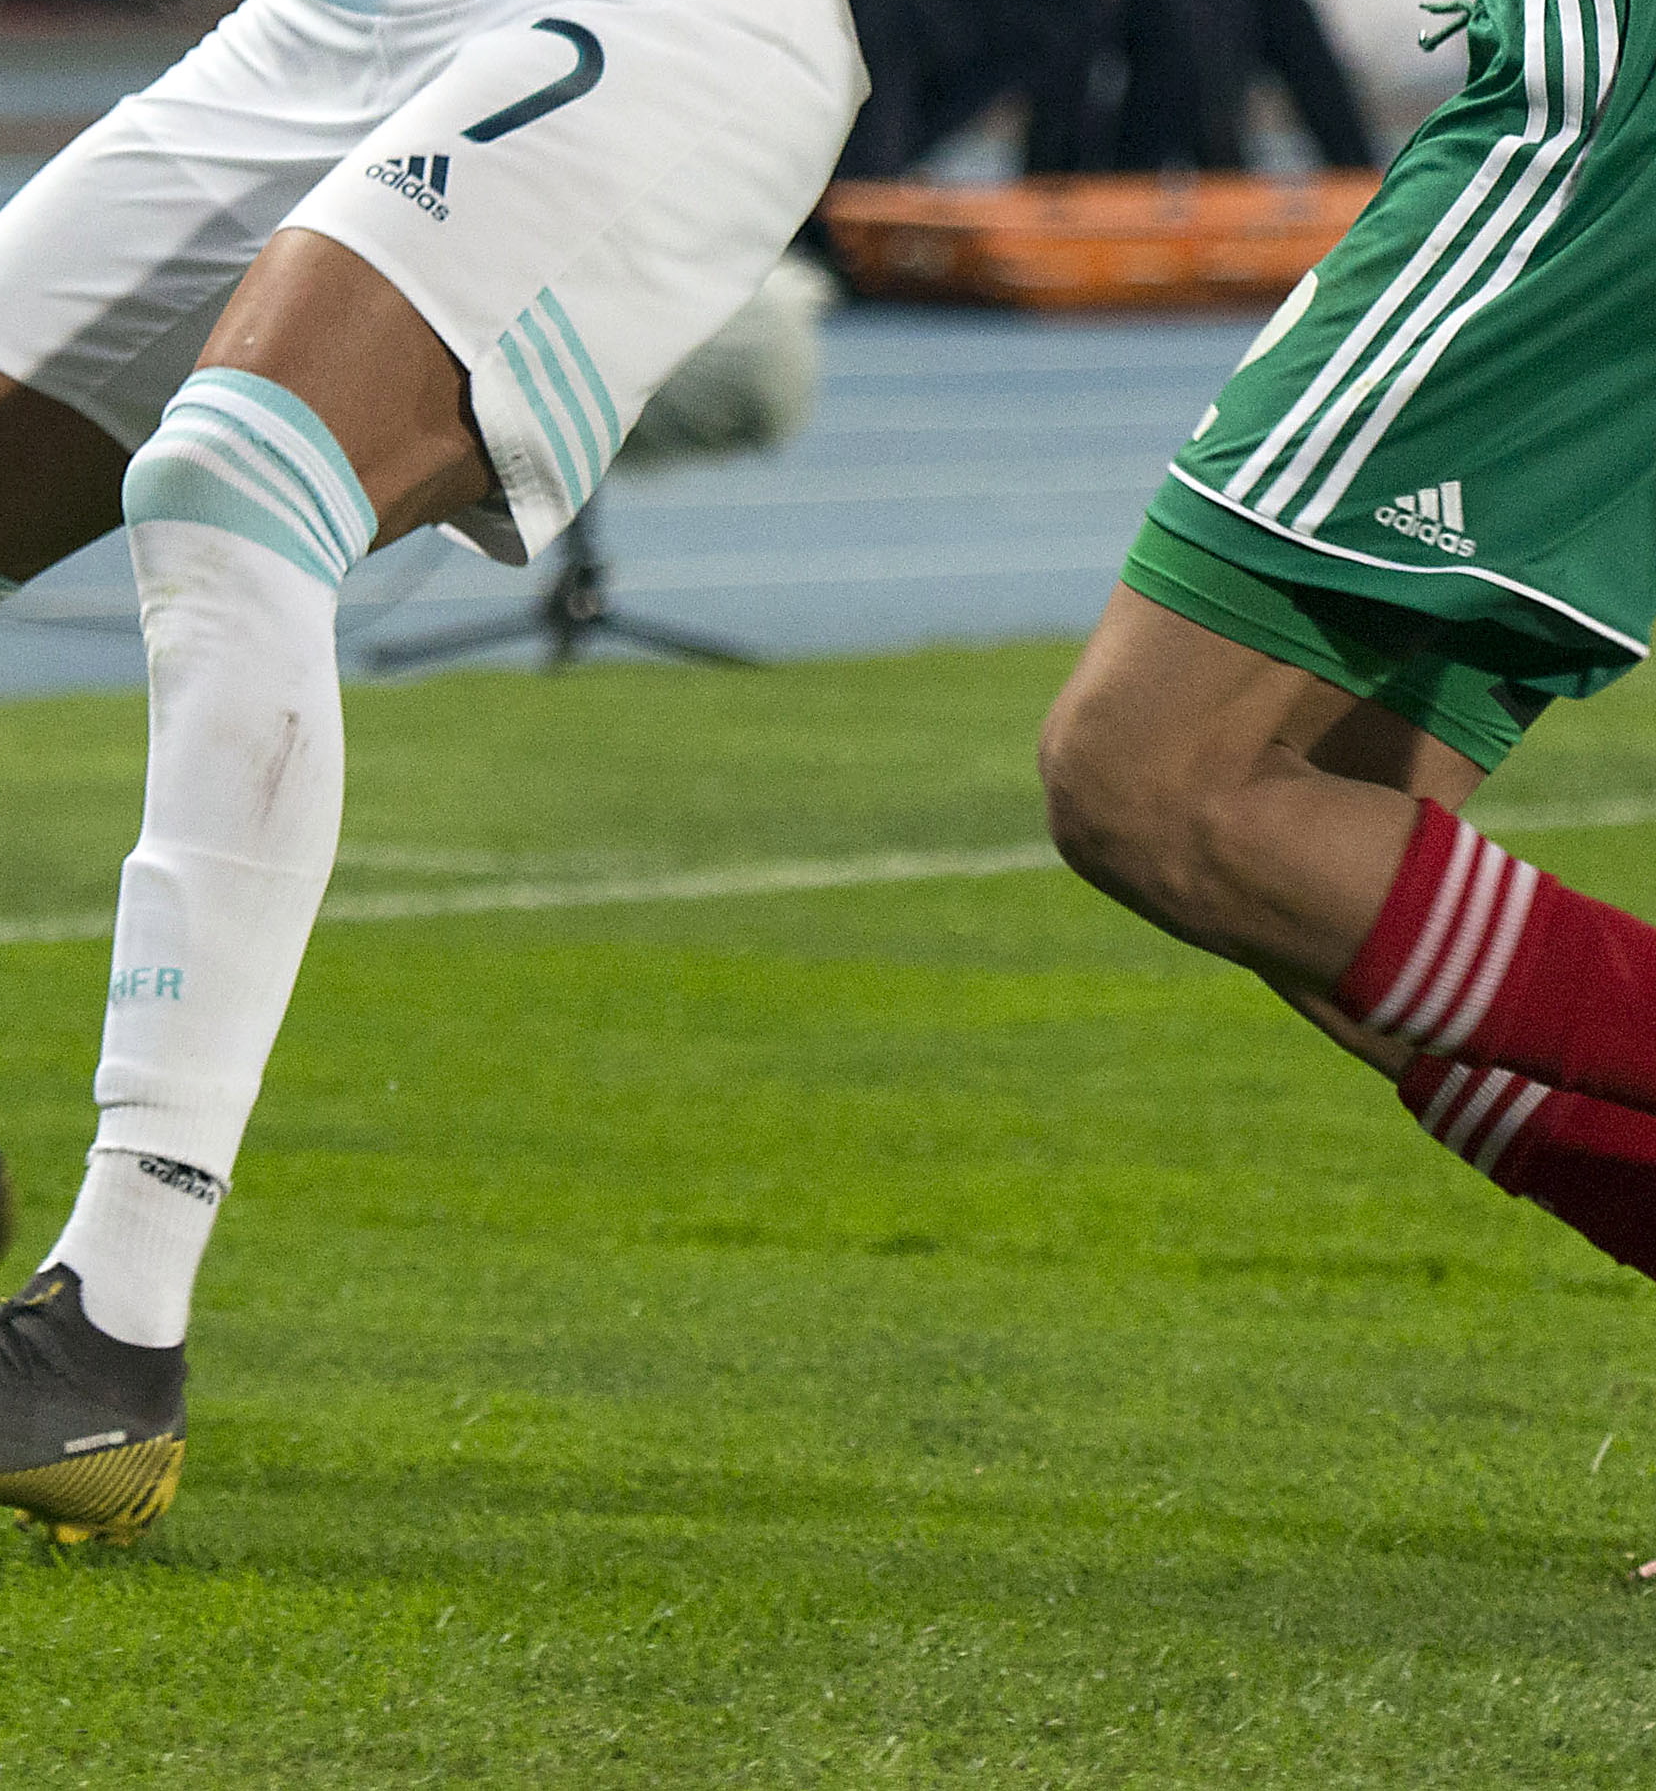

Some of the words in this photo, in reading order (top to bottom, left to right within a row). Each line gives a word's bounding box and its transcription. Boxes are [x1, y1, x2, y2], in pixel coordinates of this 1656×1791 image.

[460, 18, 605, 143] 7
[366, 164, 449, 222] adidas
[1375, 505, 1477, 558] adidas
